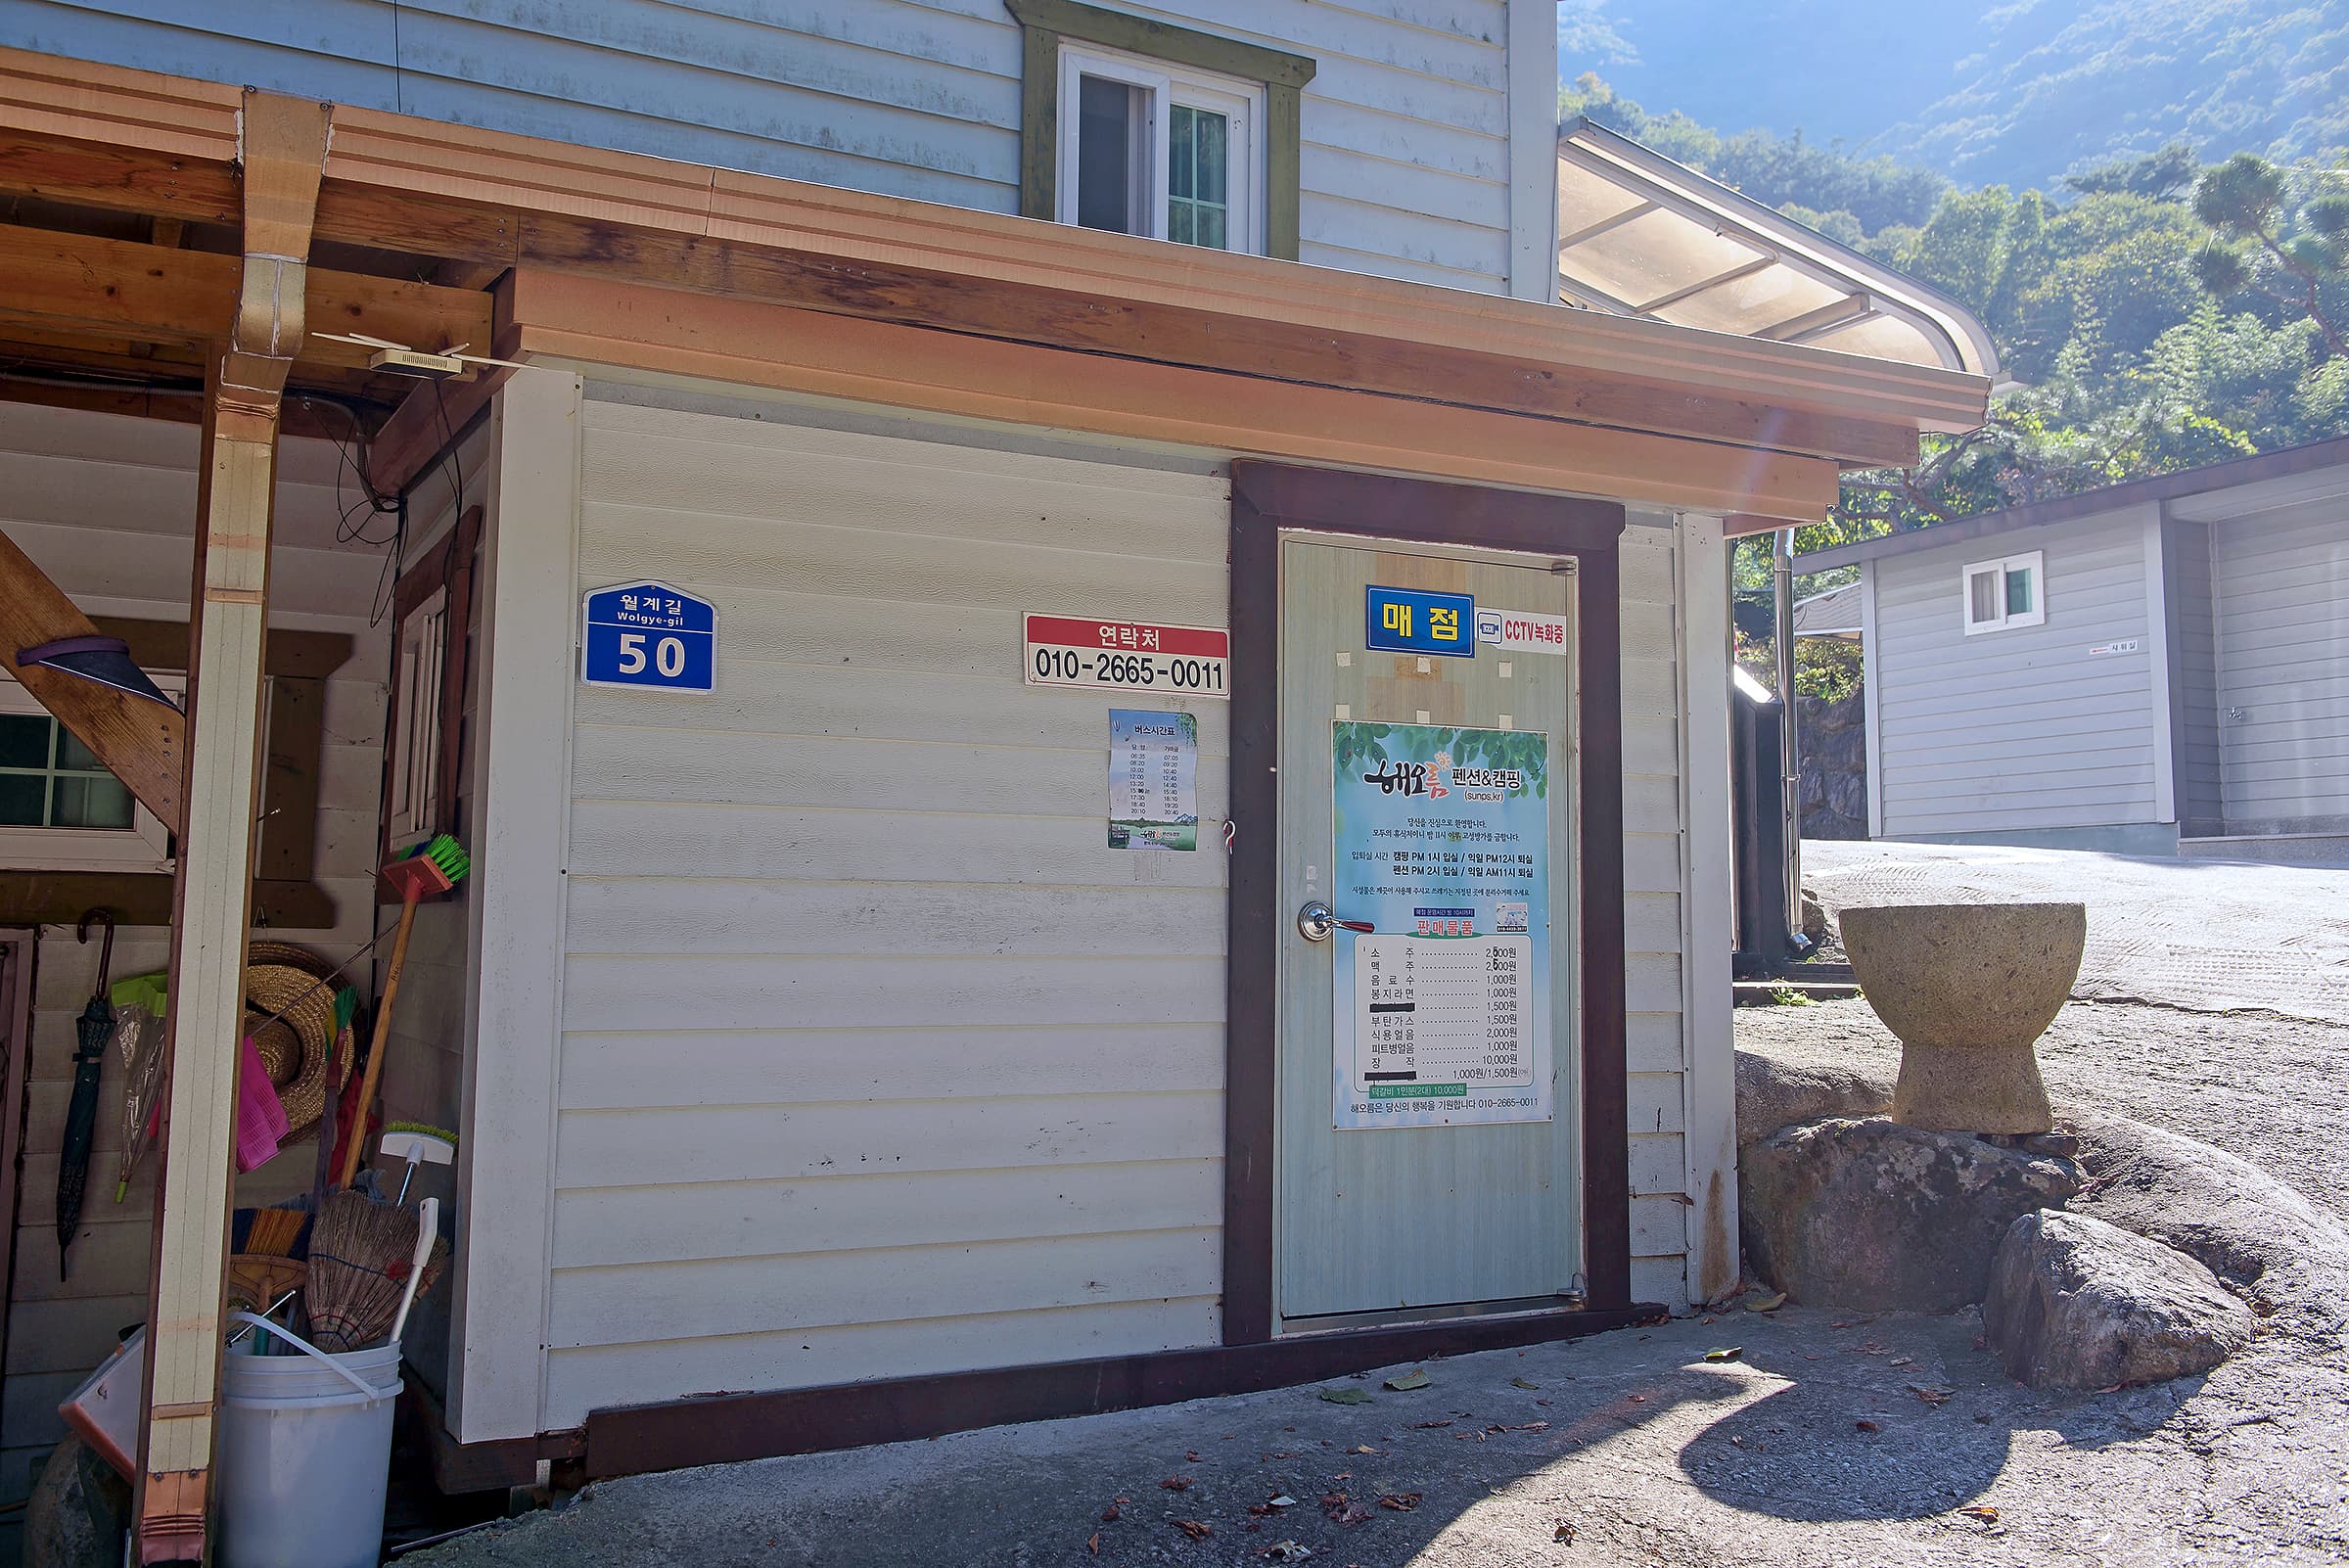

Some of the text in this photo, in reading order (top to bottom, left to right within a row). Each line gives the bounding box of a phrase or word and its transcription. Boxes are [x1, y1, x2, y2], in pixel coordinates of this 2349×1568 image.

[620, 594, 682, 615] 월계길
[618, 611, 683, 626] Wolgye-gil
[1098, 624, 1160, 650] 연락처
[619, 633, 685, 677] 50
[1036, 648, 1222, 690] 010-2665-0011
[1134, 724, 1175, 736] 버스시간표
[1451, 767, 1521, 789] 펜션&캠핑
[1374, 852, 1389, 861] 시간
[1393, 851, 1409, 861] 캠핑
[1411, 852, 1425, 861] PM
[1428, 853, 1441, 862] 1시
[1443, 853, 1458, 863] 입실
[1468, 853, 1484, 863] 익일
[1517, 854, 1533, 864] 퇴실
[1393, 865, 1409, 876] 펜션
[1411, 866, 1425, 876] PM
[1427, 866, 1440, 876] 2시
[1443, 866, 1458, 877] 입실
[1468, 866, 1484, 877] 익일
[1518, 868, 1534, 878] 퇴실
[1385, 1101, 1409, 1113] 당신의
[1478, 1097, 1539, 1109] 010-2665-0011
